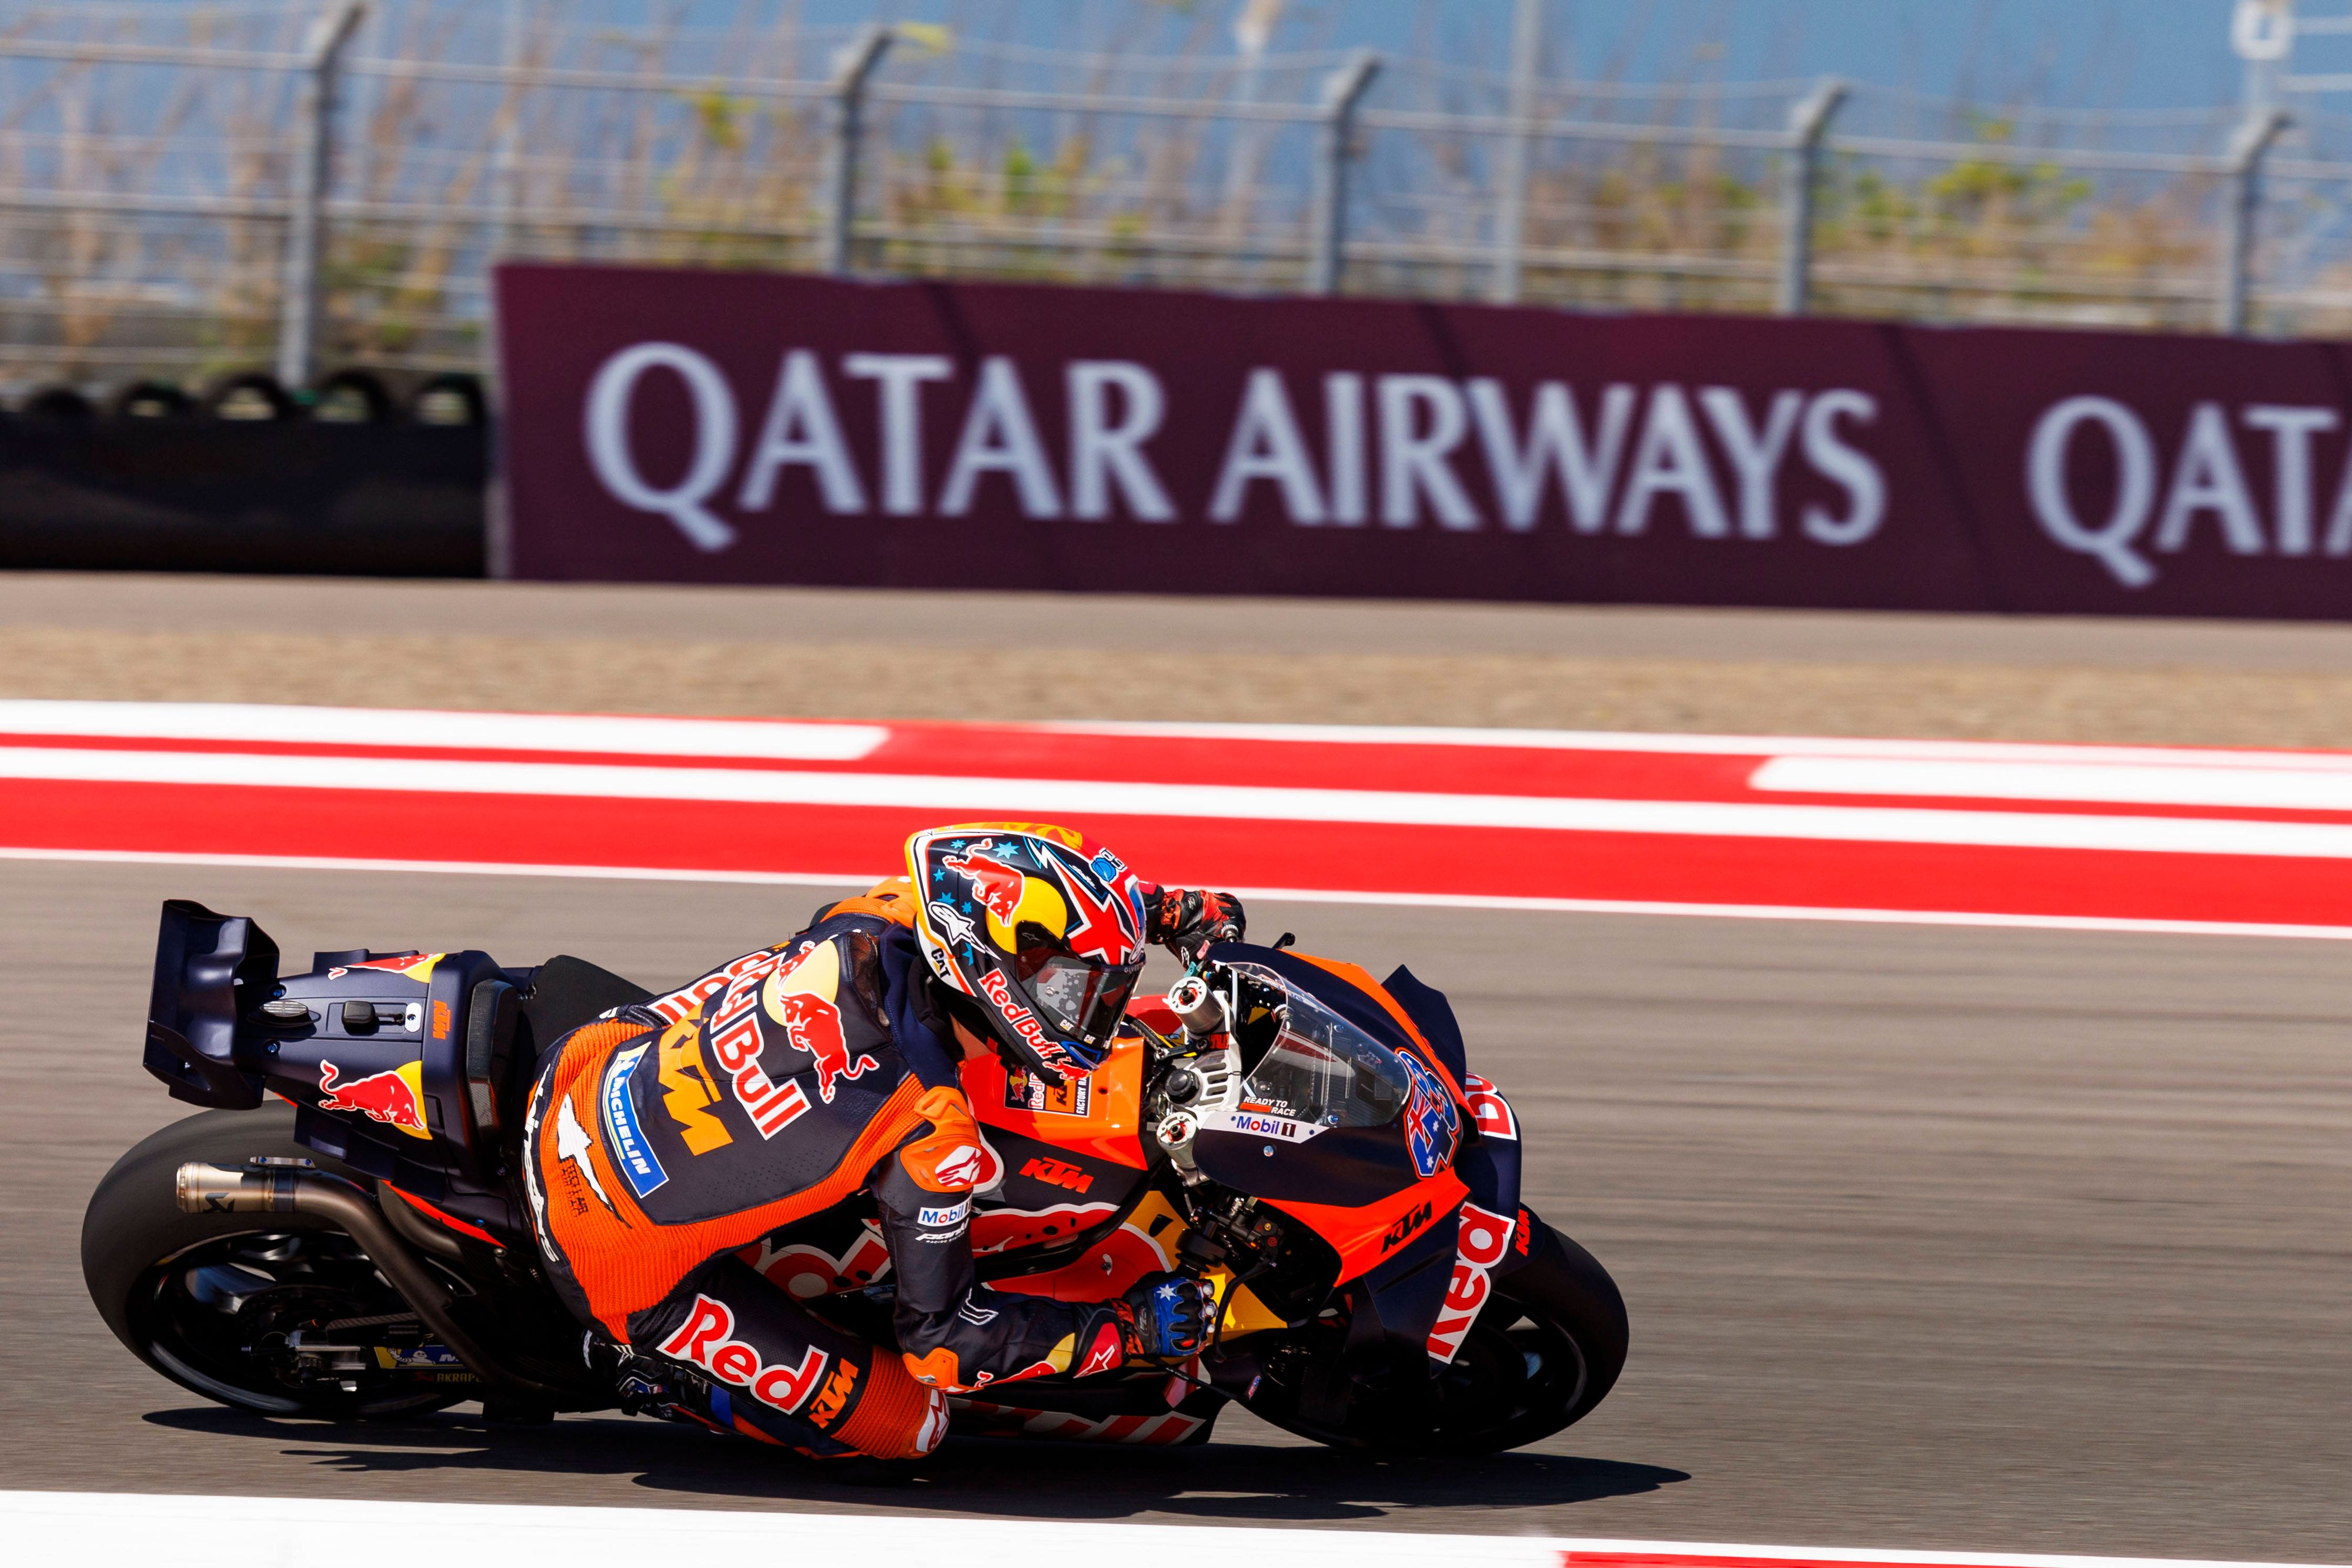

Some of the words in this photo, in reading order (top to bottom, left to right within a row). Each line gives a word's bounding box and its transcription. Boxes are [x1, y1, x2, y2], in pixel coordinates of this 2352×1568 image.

[584, 341, 1174, 551] QATAR
[1207, 366, 1886, 547] AIRWAYS
[931, 948, 949, 979] CAT
[433, 1000, 451, 1039] KTM
[978, 968, 1030, 1024] Red
[1013, 1015, 1065, 1059] Bull
[1060, 1019, 1074, 1031] CAT
[1084, 1034, 1096, 1044] CAT
[711, 1012, 811, 1141] Bull
[1076, 1086, 1086, 1114] FACTORY
[1244, 1096, 1275, 1106] READY
[1275, 1099, 1288, 1108] TO
[1271, 1107, 1296, 1116] RACE
[609, 1076, 652, 1175] MICHELIN
[1237, 1116, 1280, 1135] Mobil
[1281, 1123, 1296, 1137] 1
[1019, 1156, 1094, 1193] KTM
[921, 1205, 964, 1223] Mobil
[1381, 1200, 1432, 1254] KTM
[657, 1293, 828, 1415] Red
[437, 1373, 482, 1382] AKRAP
[808, 1358, 859, 1429] KTM
